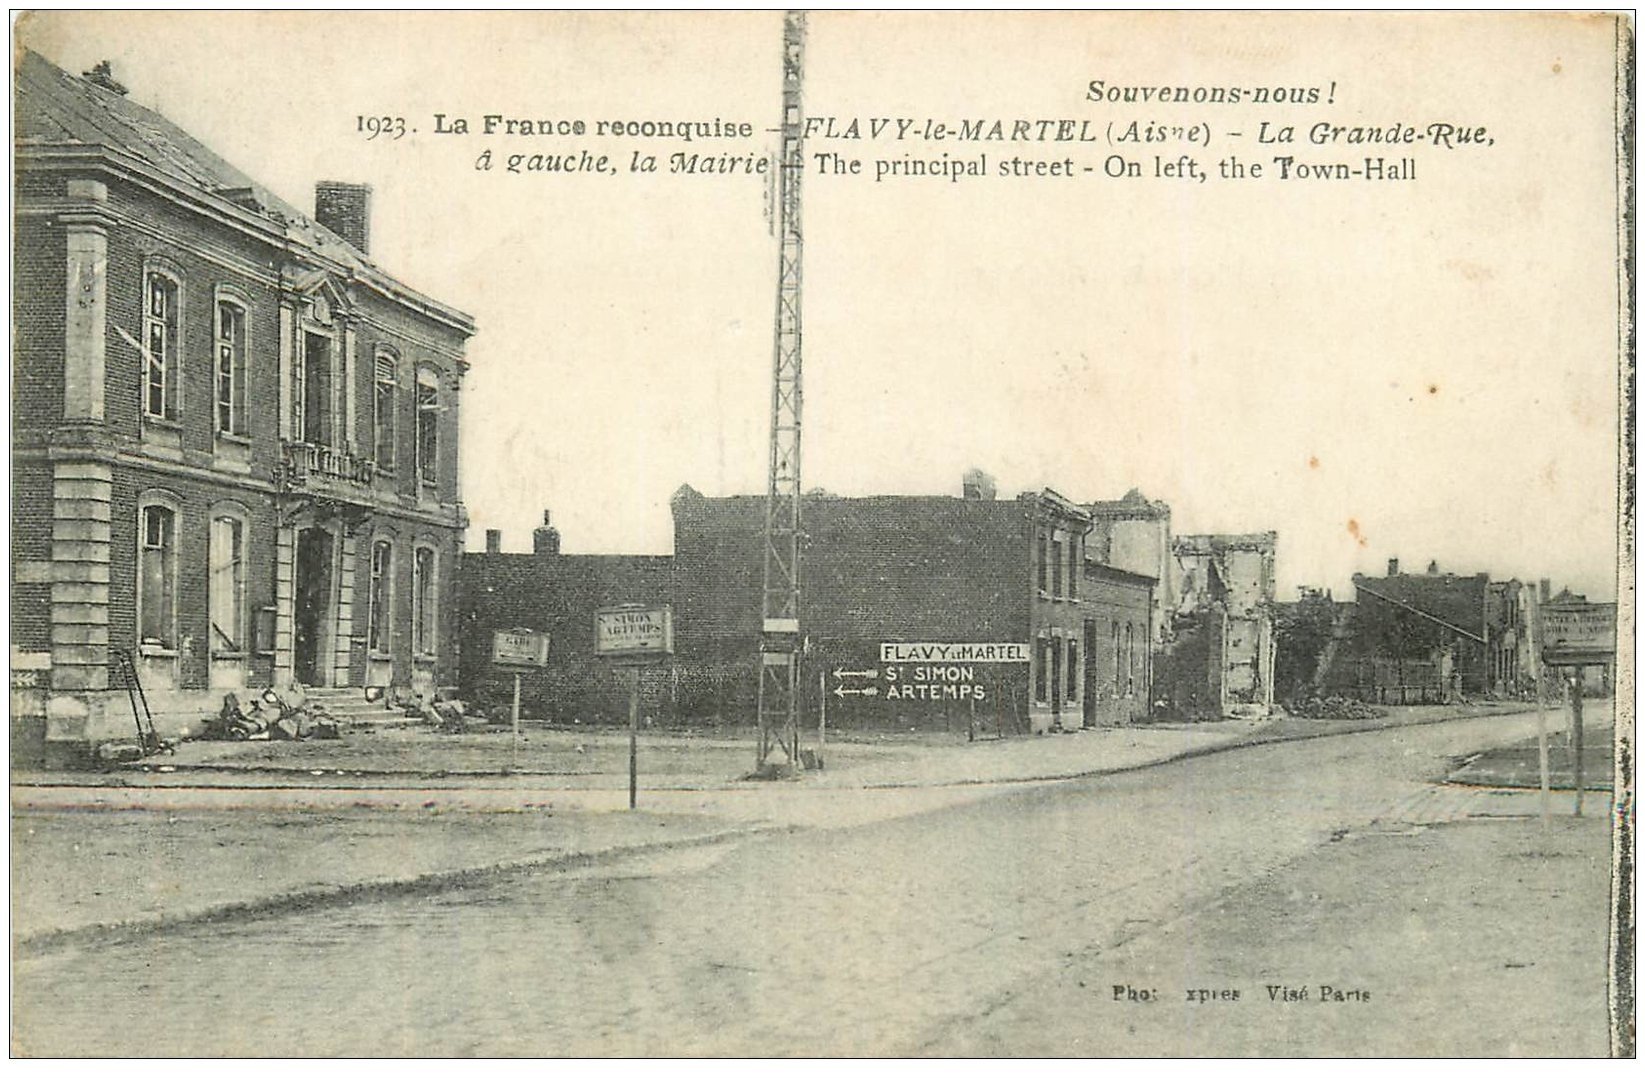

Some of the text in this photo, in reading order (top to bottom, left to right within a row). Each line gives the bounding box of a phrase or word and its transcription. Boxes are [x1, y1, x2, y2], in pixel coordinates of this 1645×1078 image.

[884, 645, 950, 660] FLAVY
[962, 645, 1026, 660] MARTEL
[914, 666, 974, 681] SIMON
[886, 684, 986, 700] ARTEMPS
